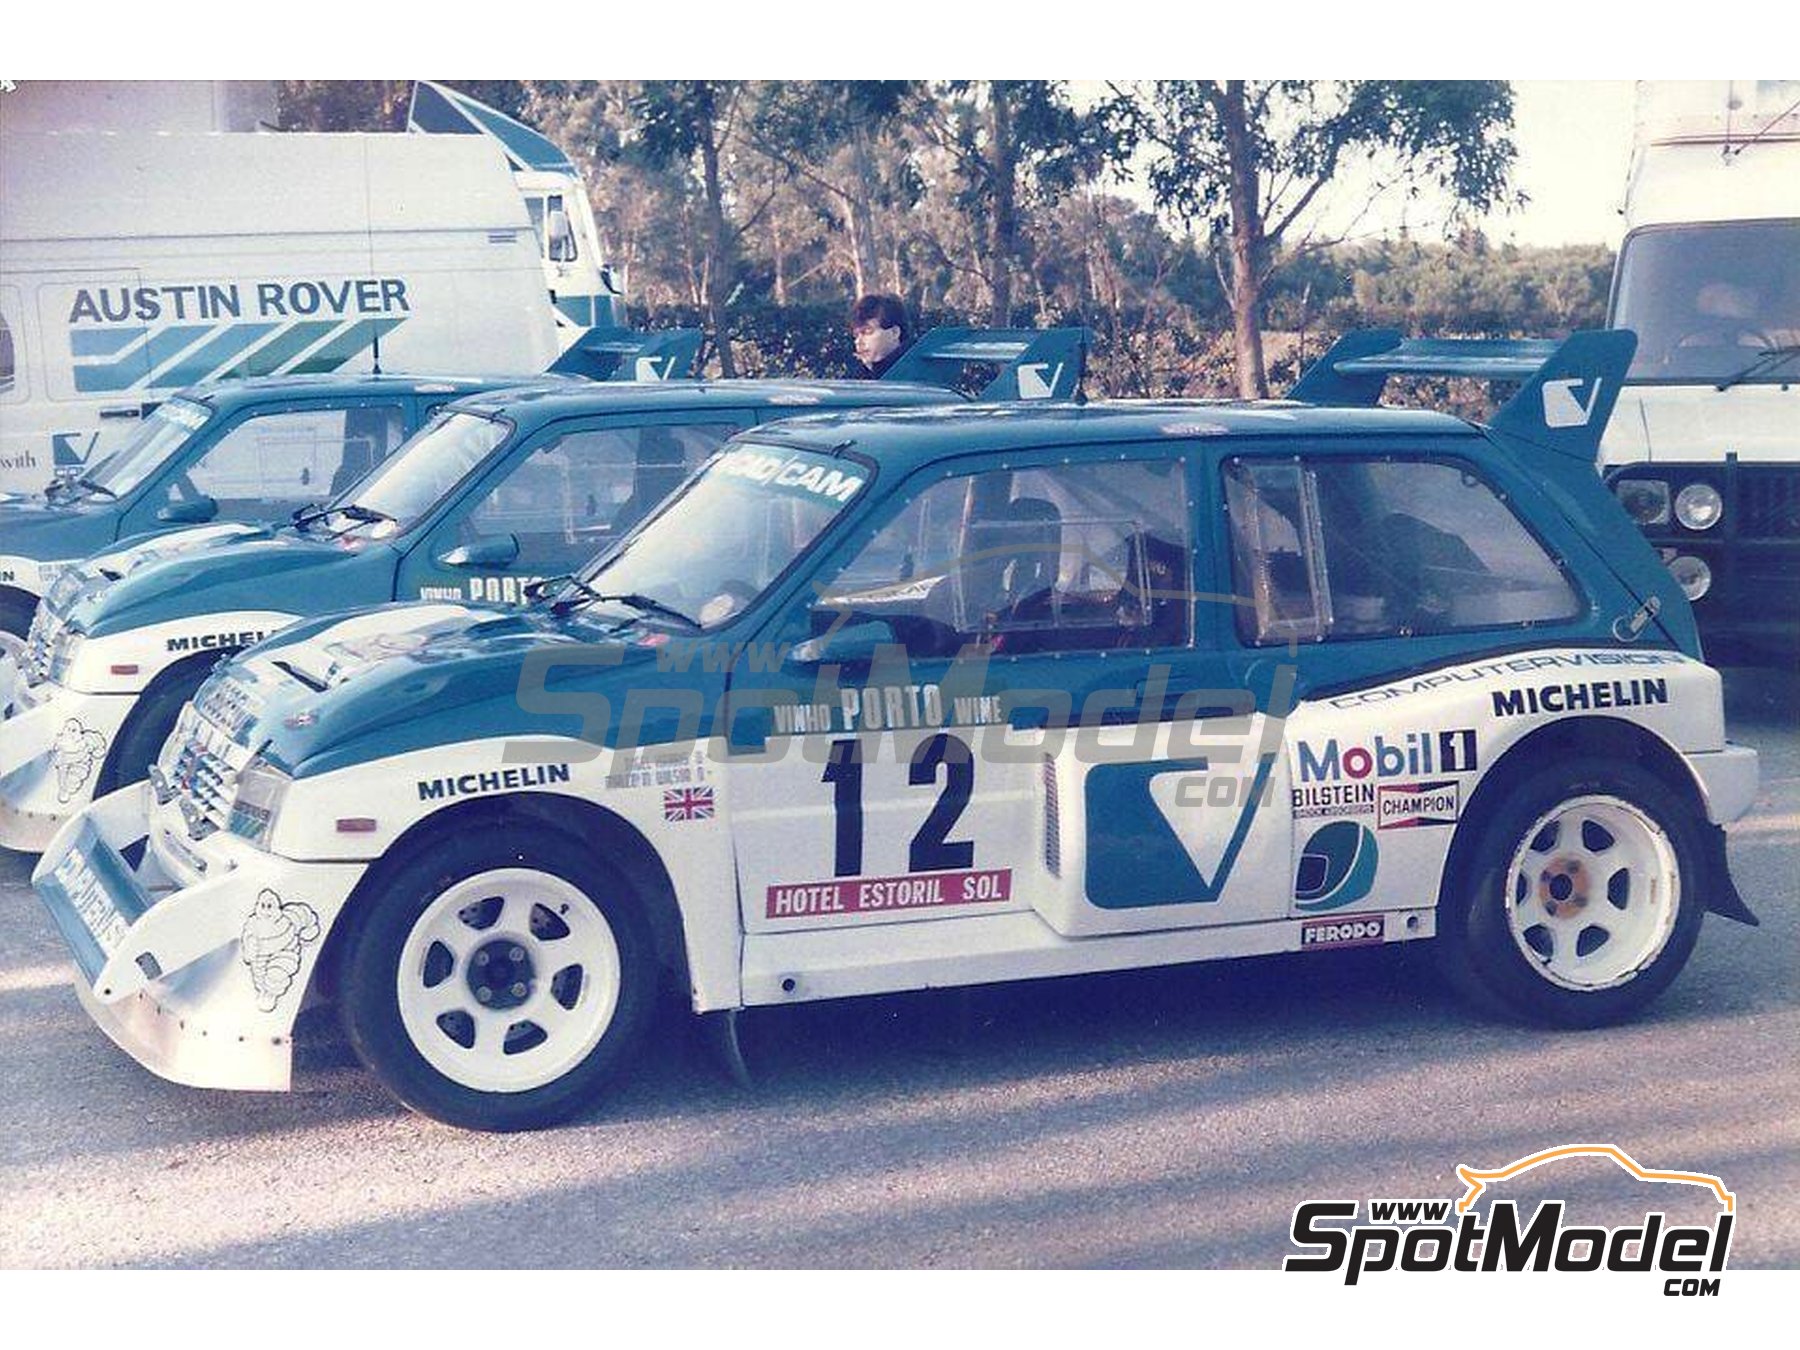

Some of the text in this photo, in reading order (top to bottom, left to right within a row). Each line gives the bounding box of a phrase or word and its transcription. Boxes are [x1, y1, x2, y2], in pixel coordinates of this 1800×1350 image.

[69, 278, 410, 323] AUSTIN ROVER
[470, 577, 543, 604] PORT
[1330, 651, 1685, 709] COMPUTERVISION
[1492, 678, 1668, 716] MICHELIN
[774, 704, 831, 733] VINHO
[841, 684, 942, 730] PORTO
[1298, 733, 1432, 782] Mobil
[417, 764, 570, 800] MICHELIN
[1292, 783, 1375, 807] BILSTEIN
[822, 733, 975, 877] 12
[1383, 796, 1454, 817] CHAMPION
[775, 874, 1002, 915] HOTEL ESTORIL SOL
[1305, 921, 1381, 943] FERODO
